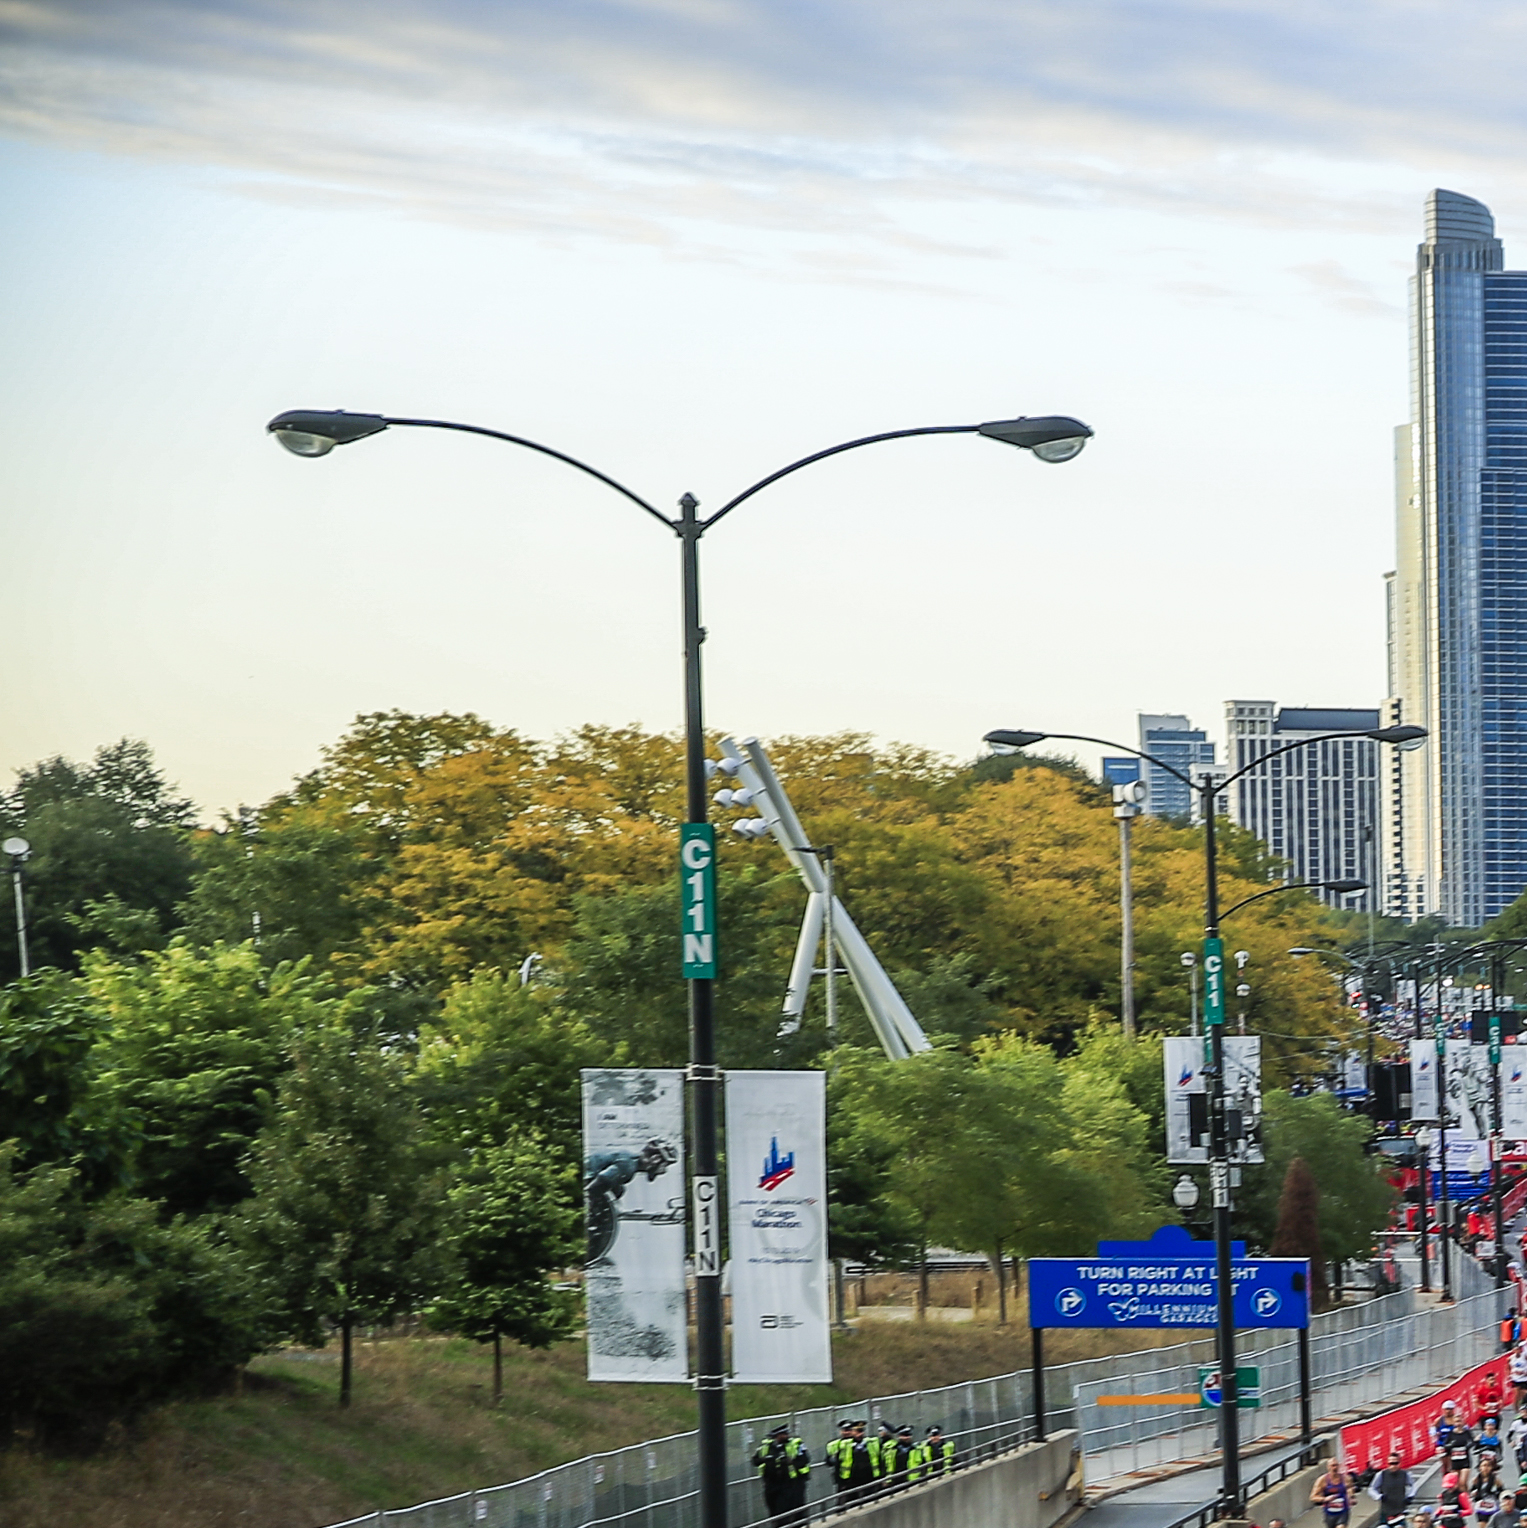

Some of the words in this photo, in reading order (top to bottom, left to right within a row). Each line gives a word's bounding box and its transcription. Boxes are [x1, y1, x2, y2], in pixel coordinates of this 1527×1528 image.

[682, 839, 713, 964] C11N
[695, 1178, 714, 1273] C11N
[1077, 1266, 1124, 1280] TURN
[1127, 1266, 1179, 1280] RIGHT
[1181, 1266, 1206, 1280] AT
[1210, 1266, 1260, 1280] LGHT
[1097, 1283, 1134, 1297] FOR
[1137, 1283, 1213, 1297] PARKING
